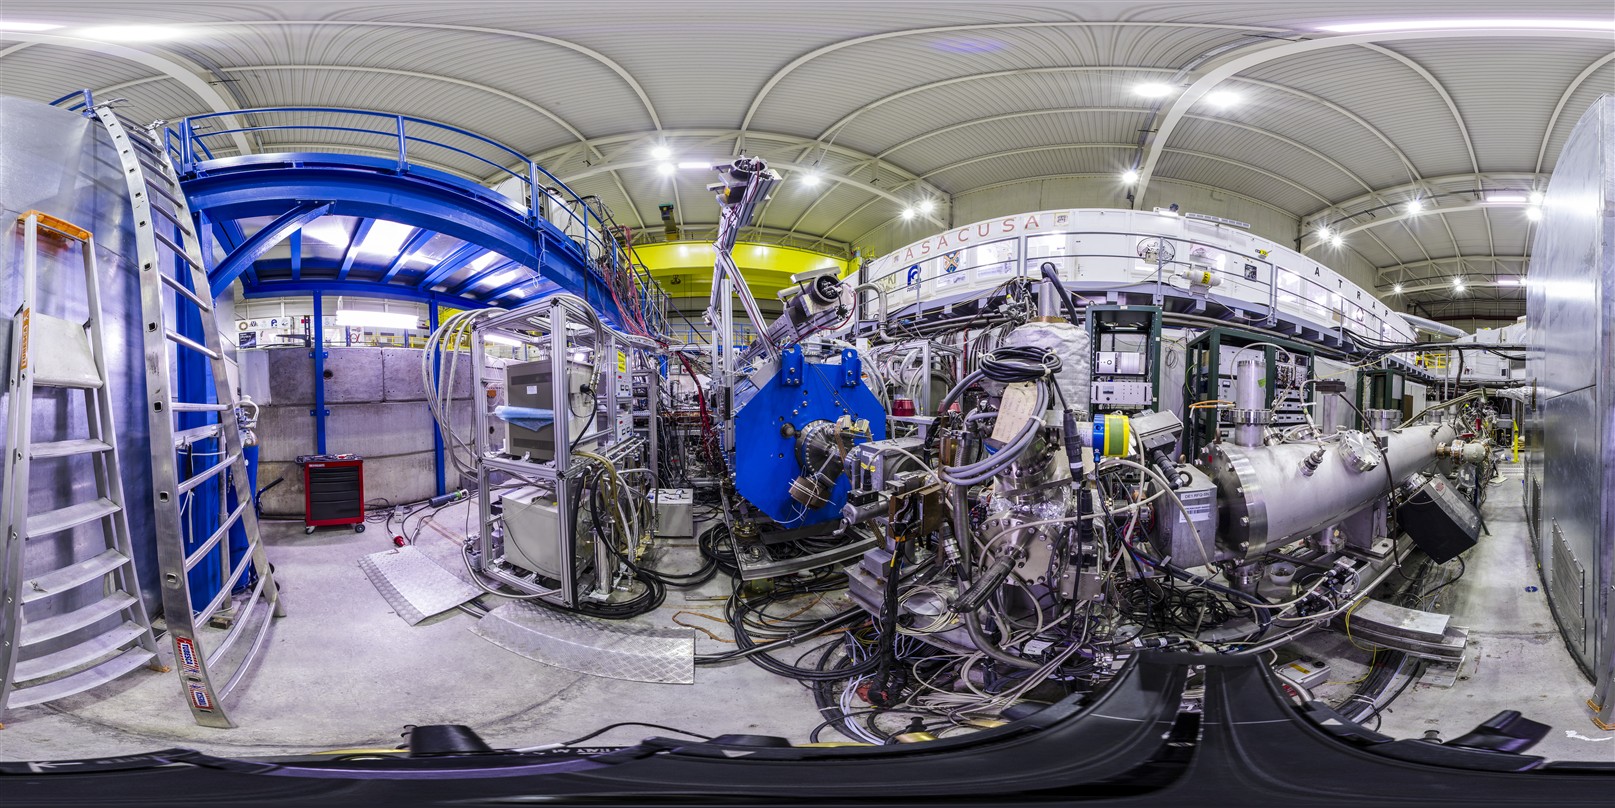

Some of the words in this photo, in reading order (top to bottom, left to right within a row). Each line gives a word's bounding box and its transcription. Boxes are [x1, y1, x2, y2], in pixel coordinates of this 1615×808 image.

[904, 214, 1040, 261] ASACUSA
[1314, 266, 1388, 317] ATRAP
[182, 644, 193, 665] TUBESCA
